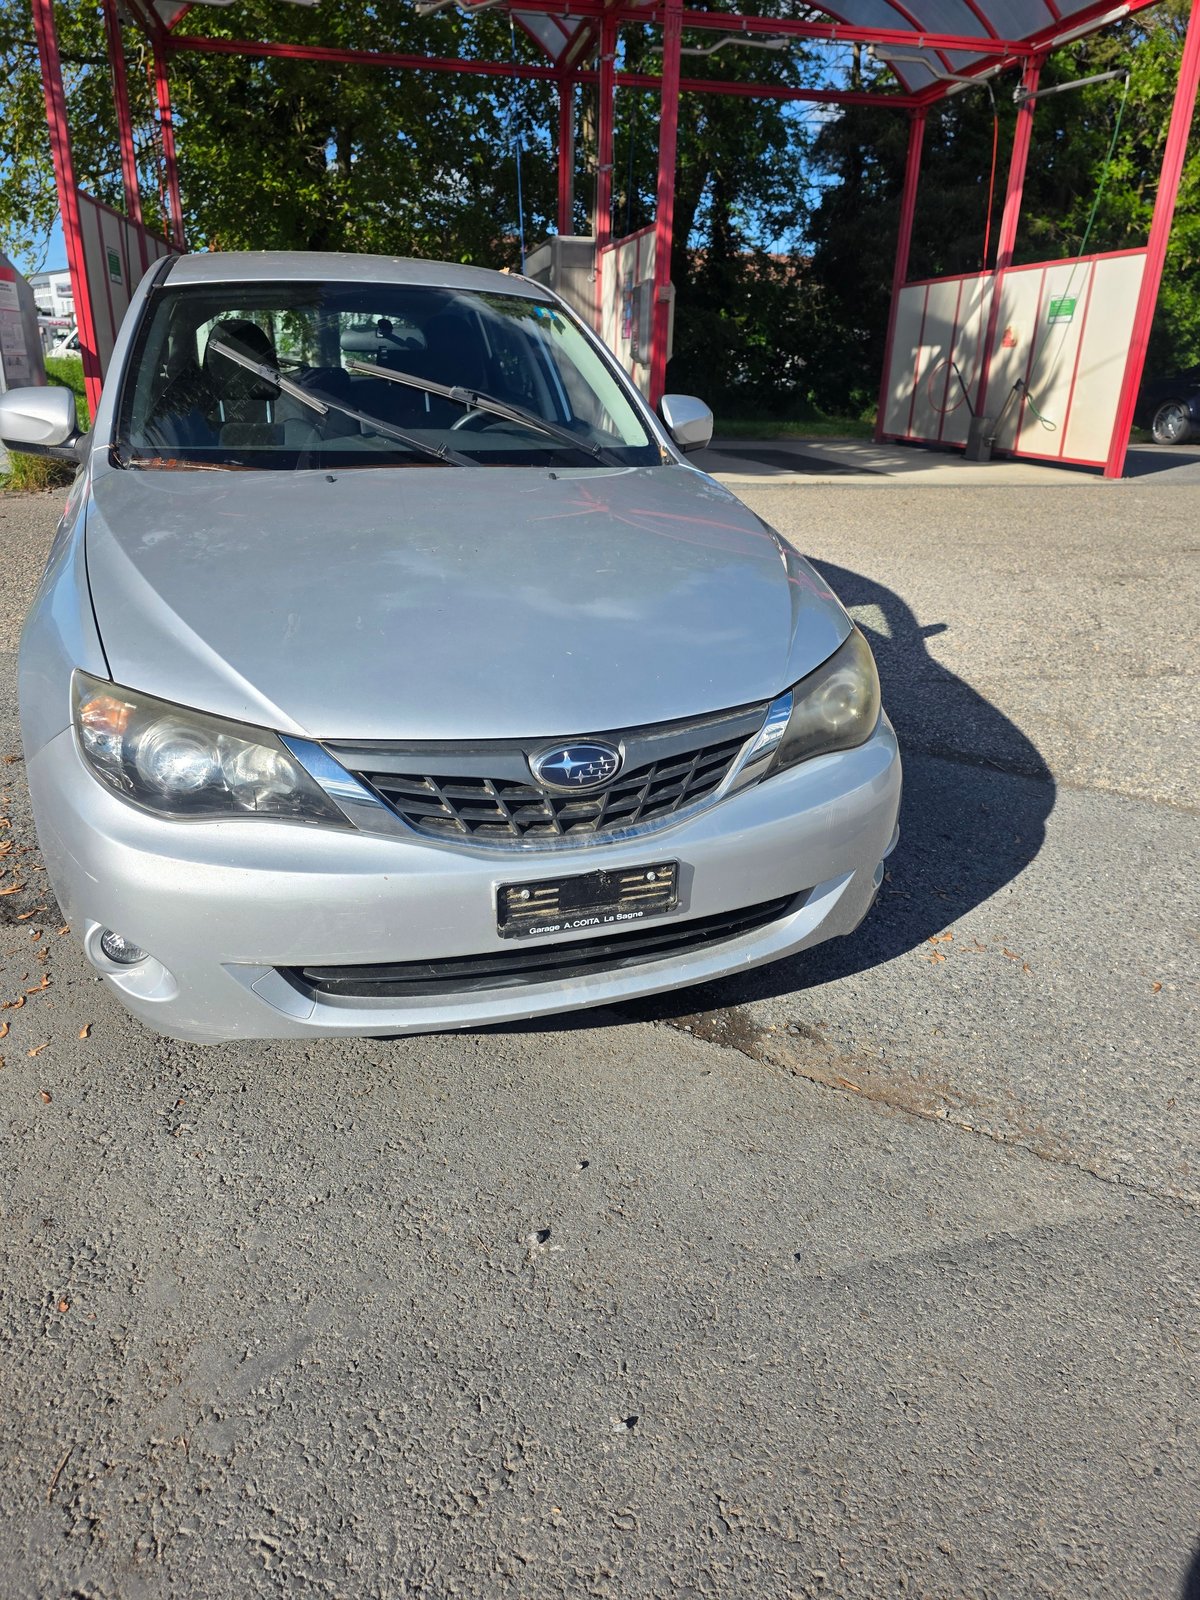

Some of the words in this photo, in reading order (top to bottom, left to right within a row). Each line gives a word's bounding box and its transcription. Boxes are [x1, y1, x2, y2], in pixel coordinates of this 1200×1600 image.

[529, 925, 560, 934] Garage
[604, 915, 615, 923] La
[616, 911, 643, 920] Sagne
